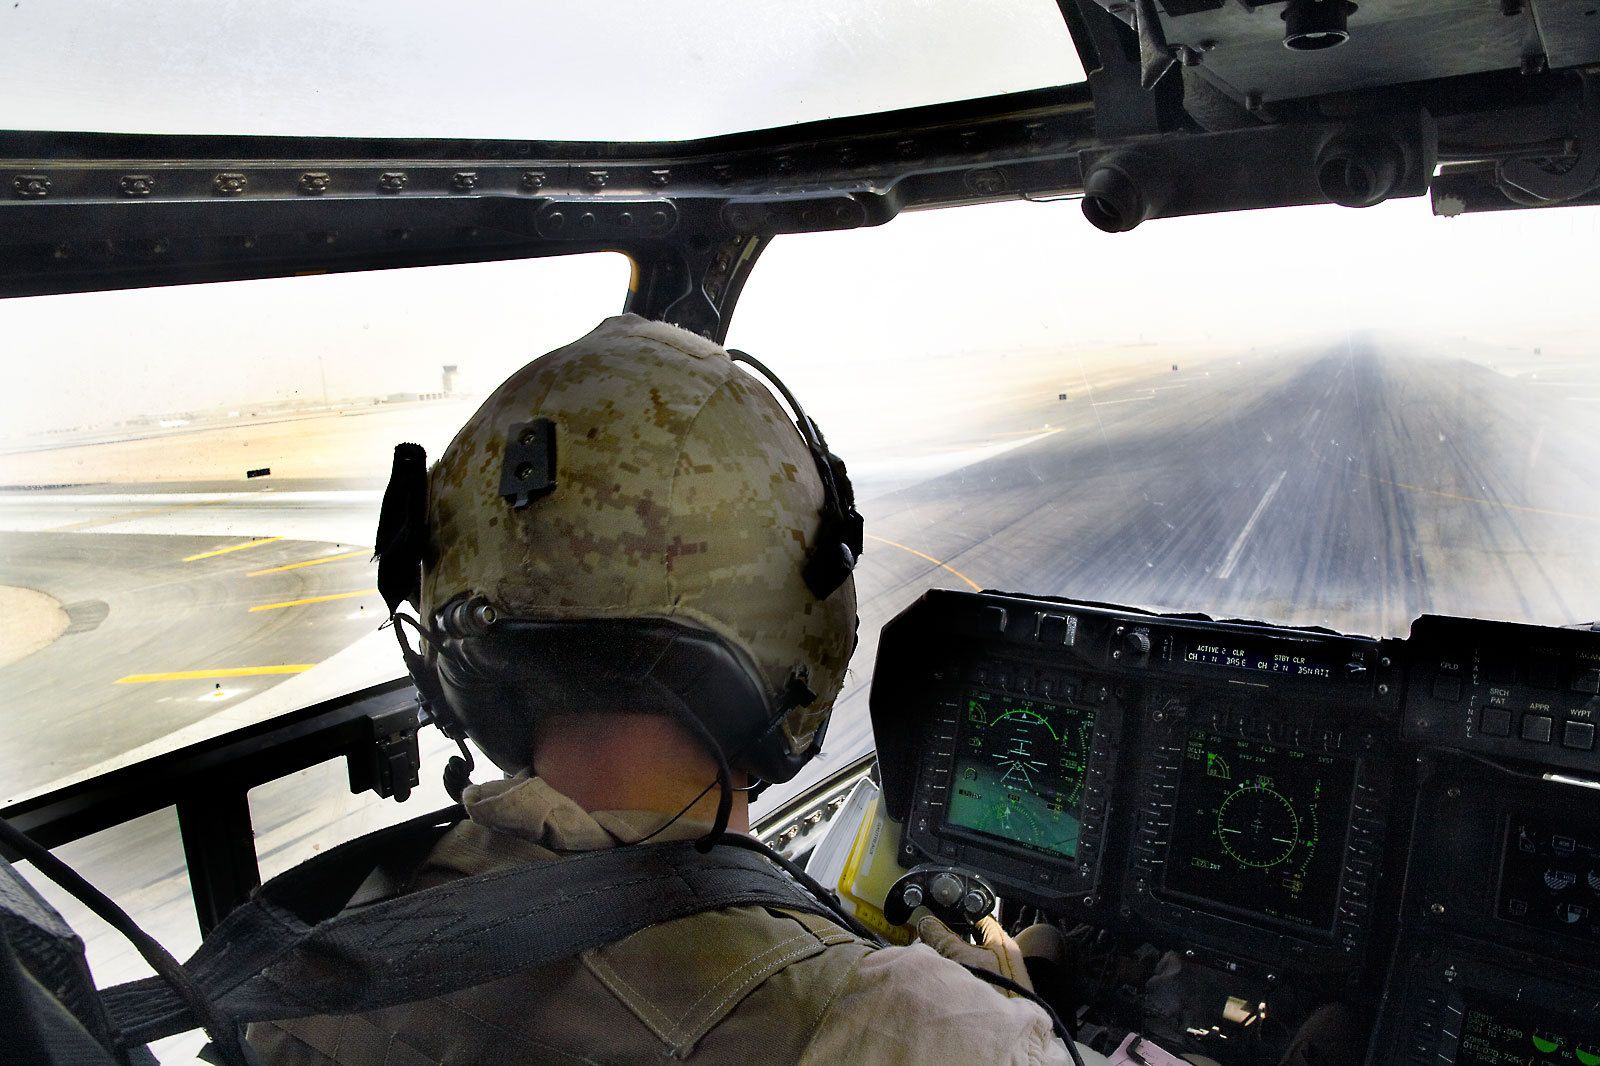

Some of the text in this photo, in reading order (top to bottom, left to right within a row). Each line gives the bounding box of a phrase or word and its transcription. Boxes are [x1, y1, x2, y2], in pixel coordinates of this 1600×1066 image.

[1196, 644, 1219, 654] ACTIVE
[1232, 649, 1245, 657] CLR
[1188, 652, 1198, 661] CH
[1274, 654, 1306, 664] STBY CLR
[1257, 661, 1268, 670] CH
[1273, 662, 1279, 671] 2
[1489, 687, 1510, 697] SRCH
[1490, 696, 1506, 705] PAT
[1529, 702, 1550, 712] APPR
[1569, 708, 1592, 718] WYPT
